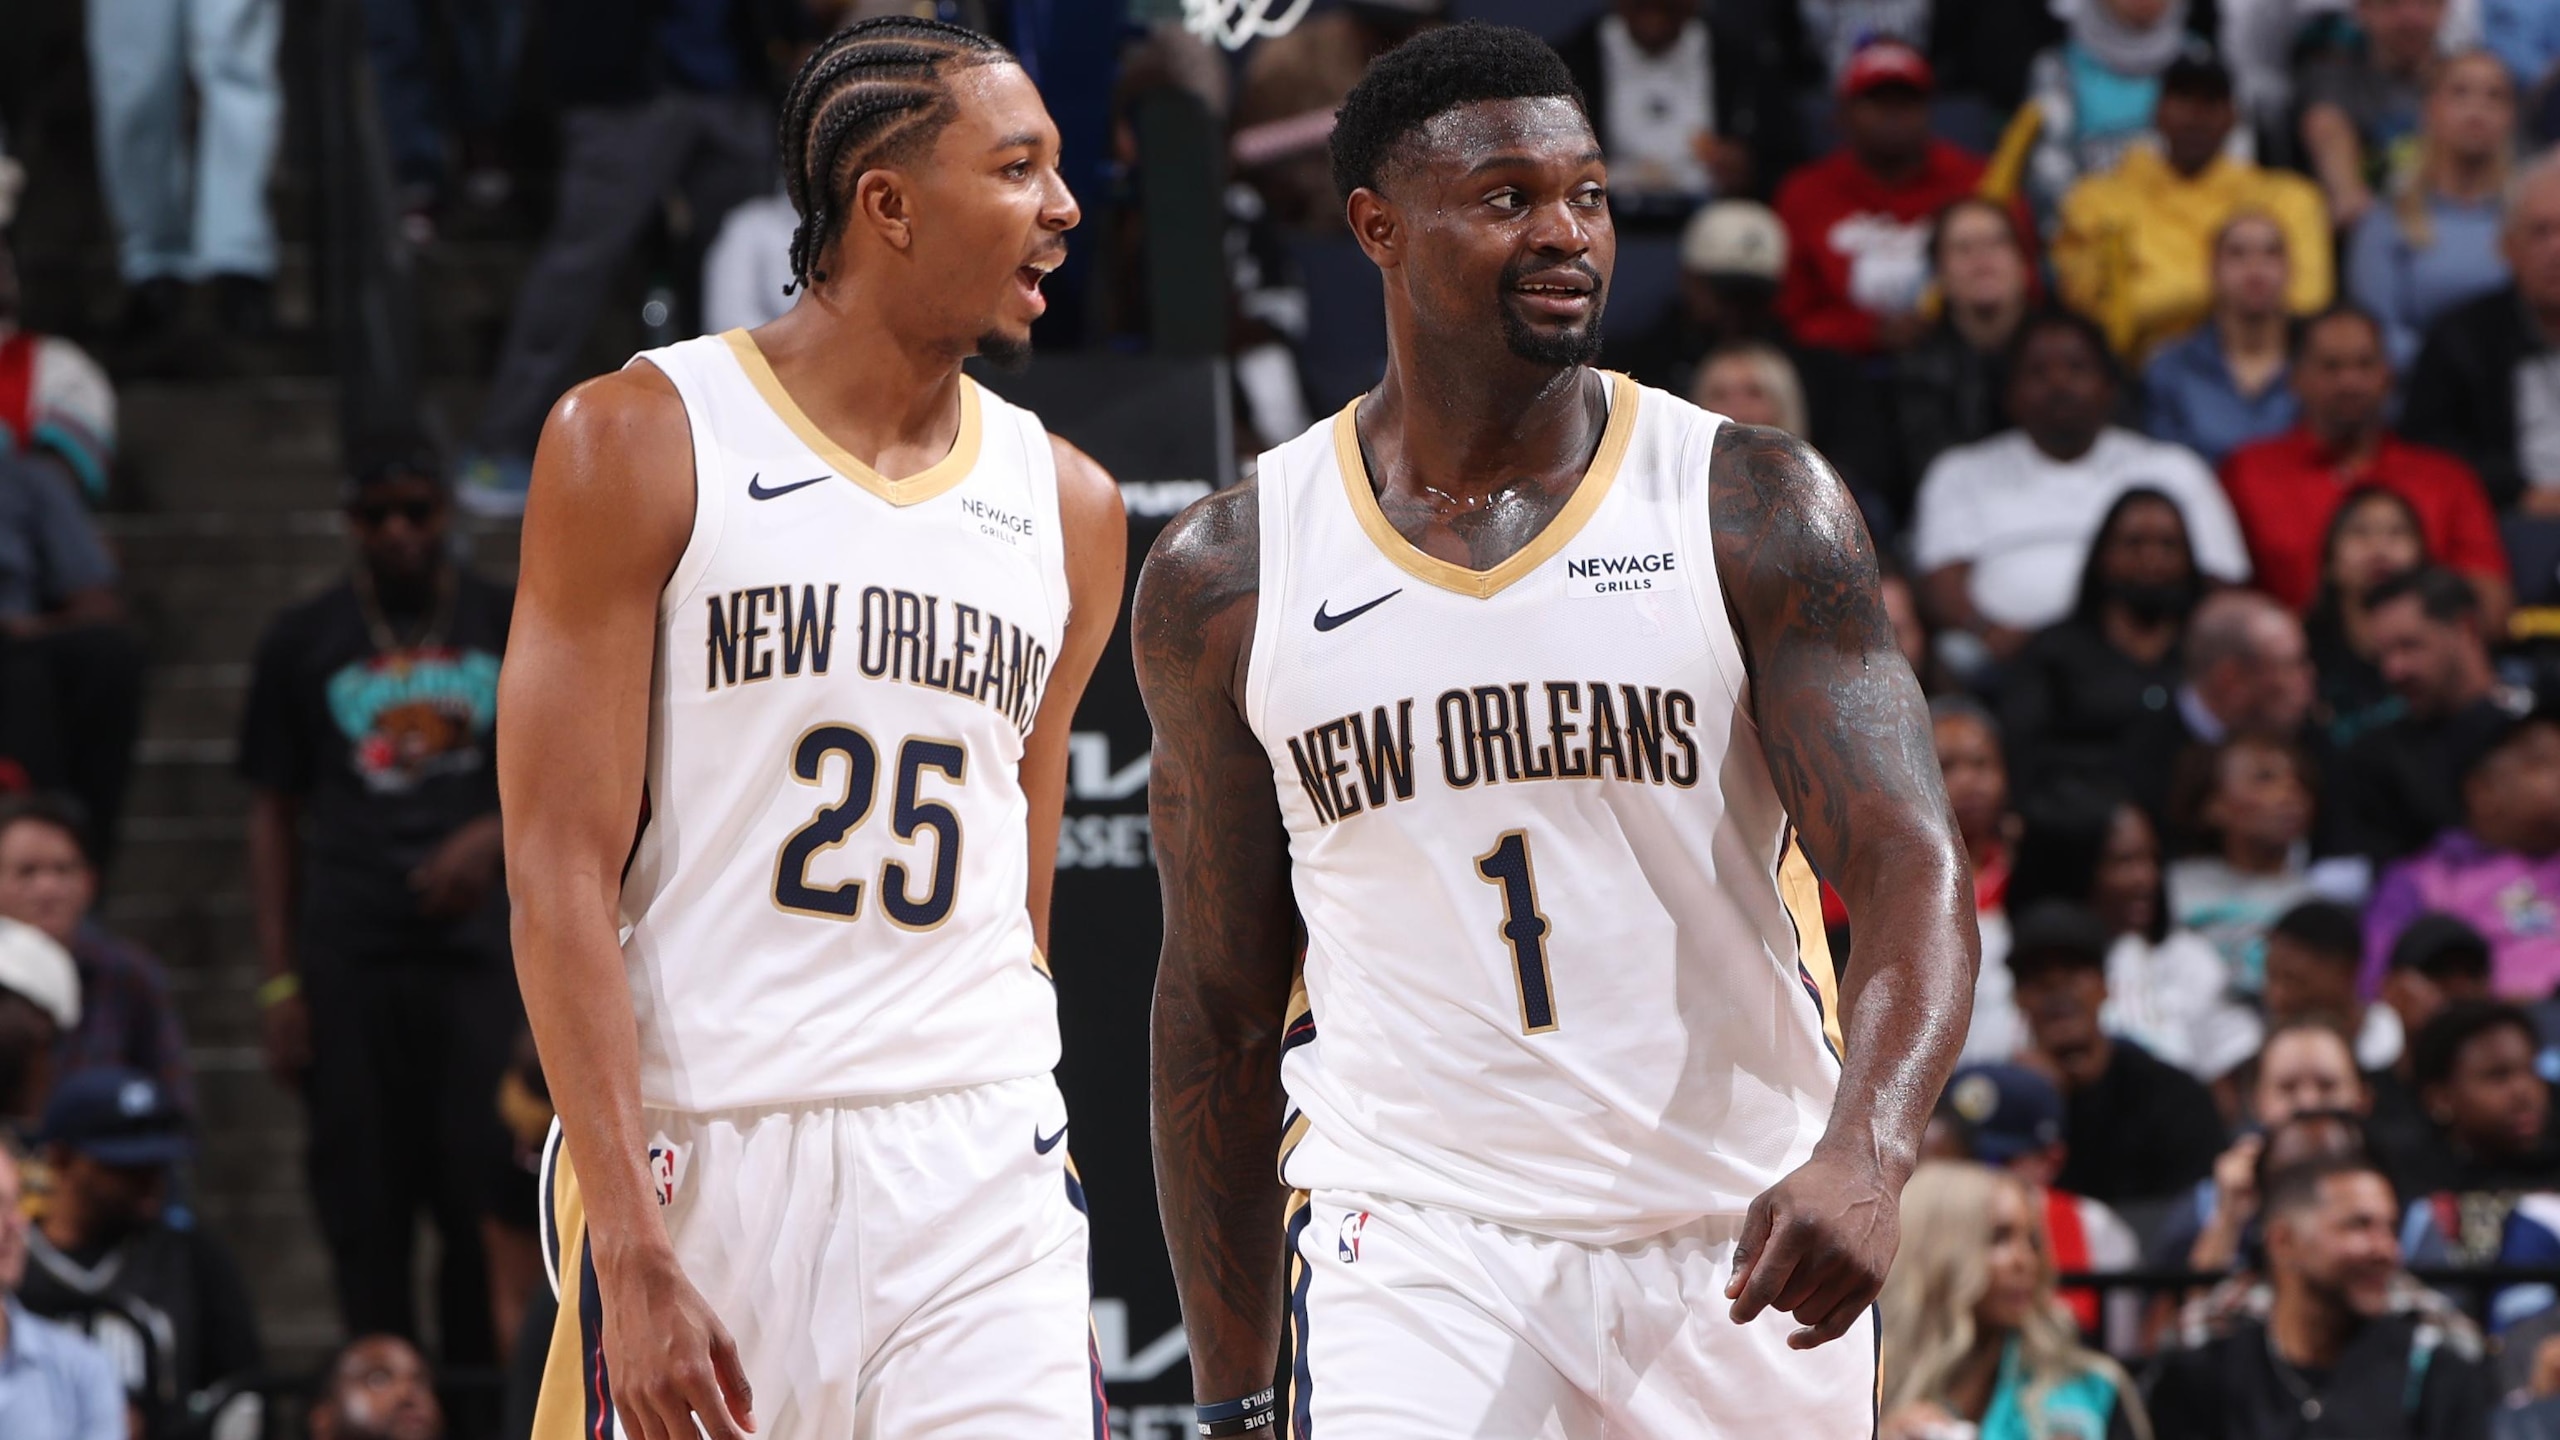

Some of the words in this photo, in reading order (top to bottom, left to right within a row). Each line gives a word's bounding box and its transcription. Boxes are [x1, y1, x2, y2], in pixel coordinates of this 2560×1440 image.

[961, 498, 1033, 536] NEWAGE
[980, 525, 1016, 545] GRILLS
[1568, 553, 1675, 578] NEWAGE
[1595, 579, 1651, 593] GRILLS
[706, 583, 840, 692] NEW
[859, 585, 1047, 737] ORLEANS
[1287, 698, 1415, 826] NEW
[1436, 681, 1700, 790] ORLEANS
[771, 721, 968, 933] 25
[1473, 828, 1560, 1035] 1
[1244, 1415, 1265, 1430] DIE
